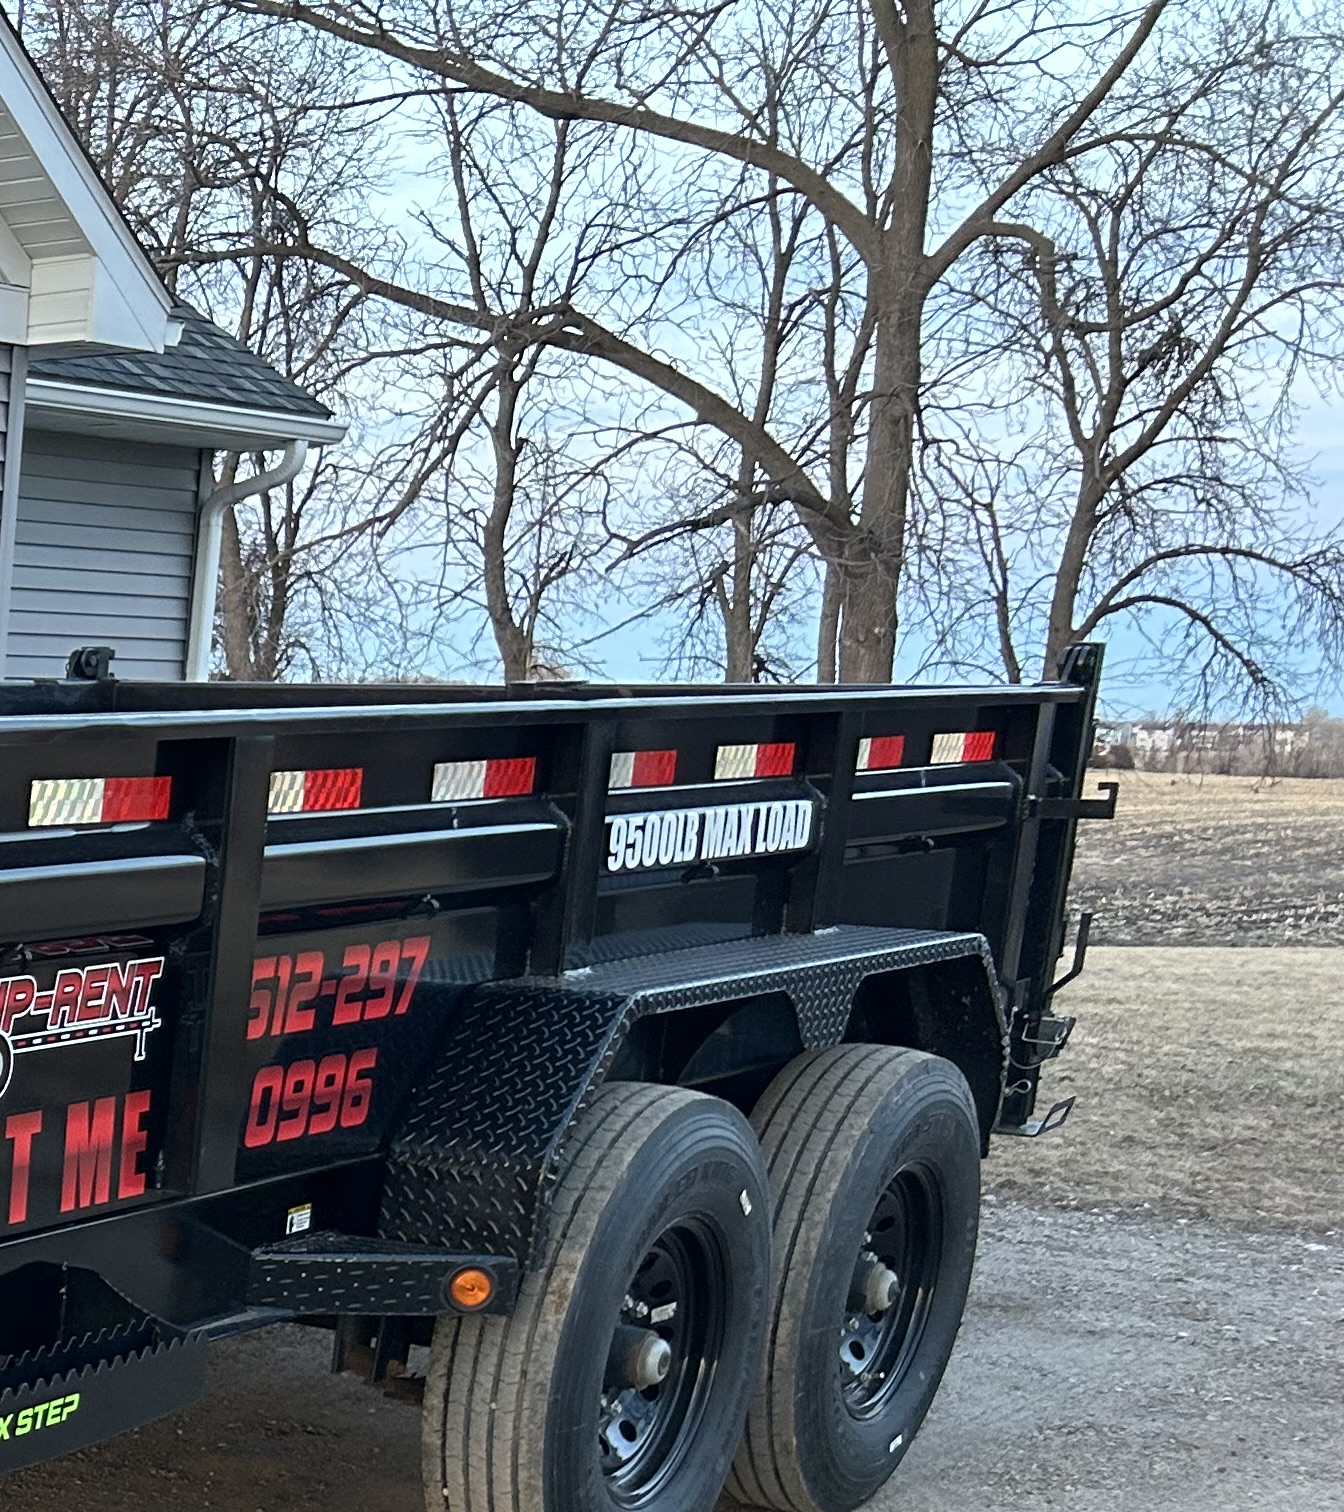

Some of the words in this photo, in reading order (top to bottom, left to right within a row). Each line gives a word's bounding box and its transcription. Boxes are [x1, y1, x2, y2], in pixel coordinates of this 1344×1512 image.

[607, 812, 699, 872] 9500LB
[700, 805, 755, 861] MAX
[755, 801, 812, 854] LOAD
[244, 1047, 379, 1148] 0996
[60, 1090, 151, 1214] ME
[15, 1393, 81, 1437] STEP
